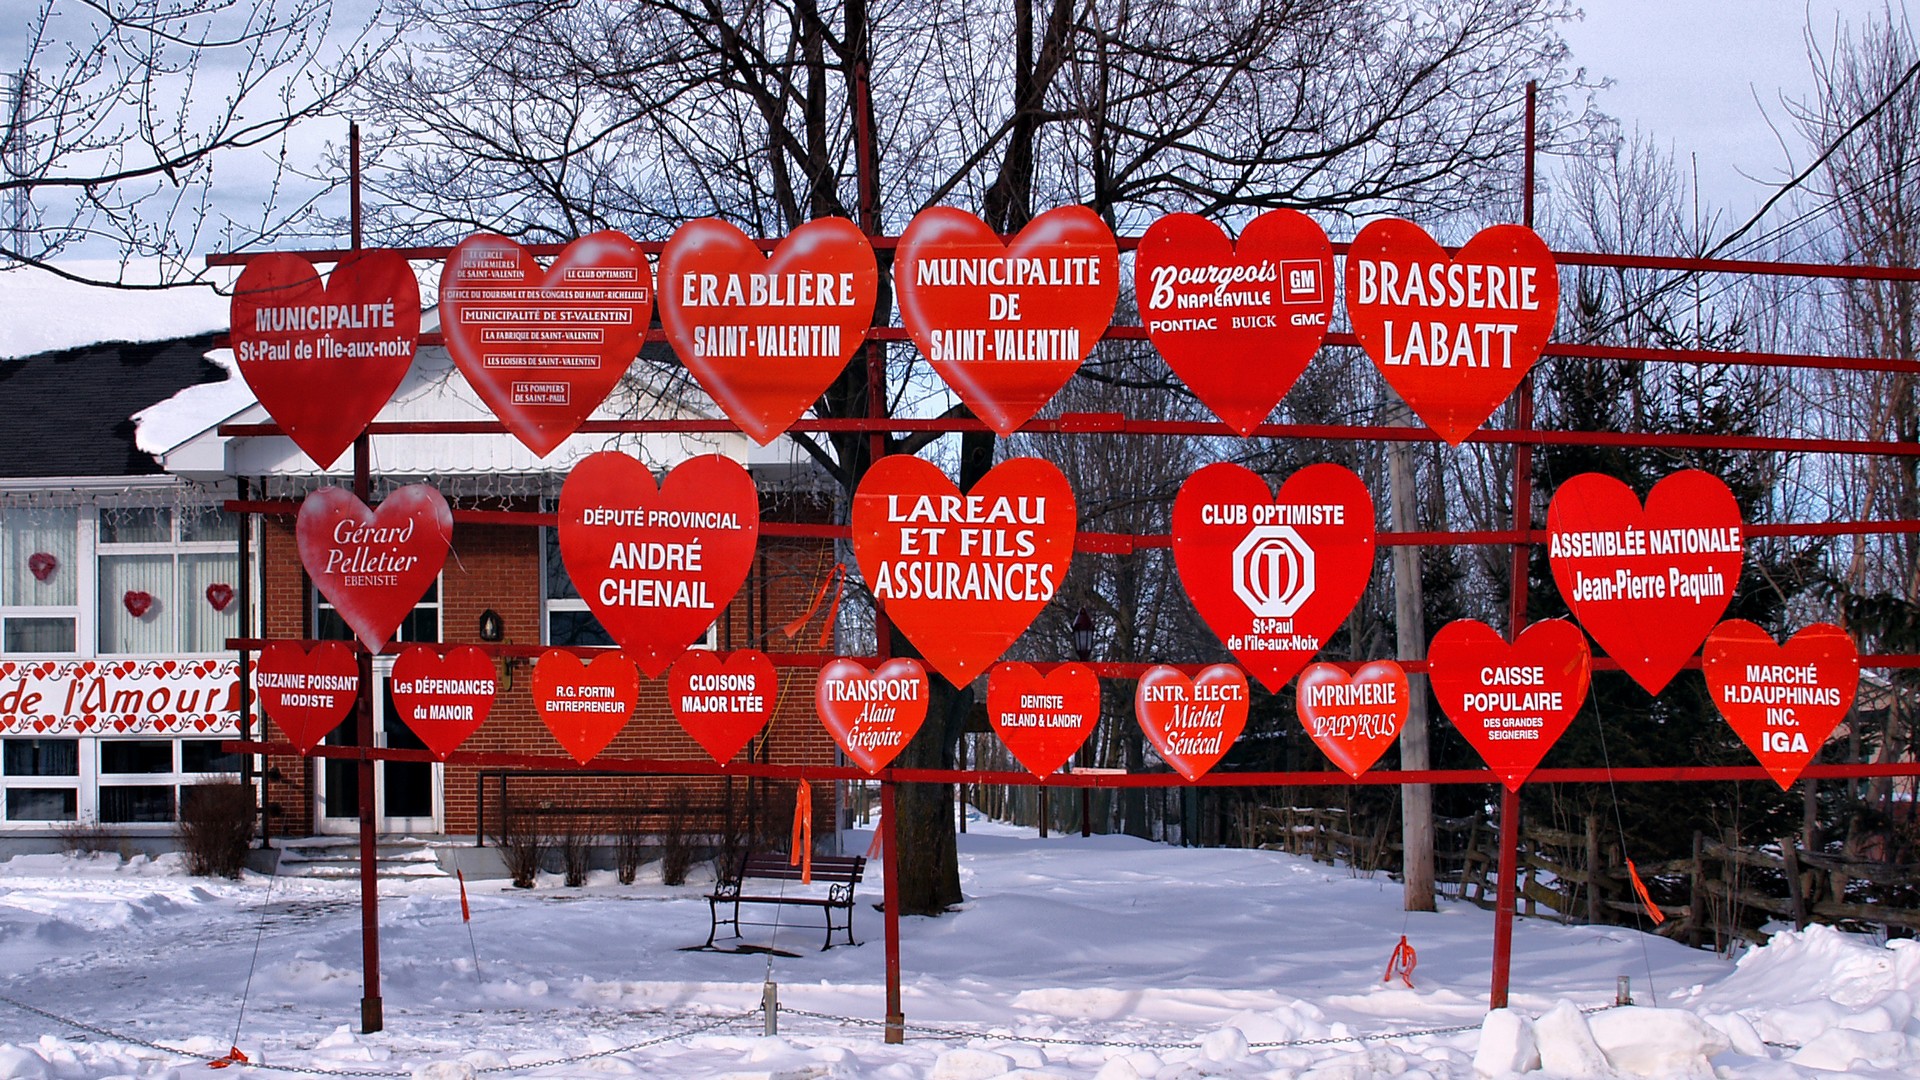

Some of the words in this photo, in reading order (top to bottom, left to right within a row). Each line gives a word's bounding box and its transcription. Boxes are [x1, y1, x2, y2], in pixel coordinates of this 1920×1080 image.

[464, 261, 476, 269] DES
[470, 251, 478, 259] LE
[479, 251, 503, 259] CERCLE
[458, 270, 466, 278] DE
[467, 270, 524, 278] SAINT-VALENTIN
[917, 255, 1100, 286] MUNICIPALITÉ
[1290, 270, 1315, 288] GM
[575, 291, 585, 299] DU
[586, 291, 643, 299] HAUT-RICHELIEU
[682, 270, 856, 306] ÉRABLIÈRE
[1149, 260, 1277, 309] Bourgeois
[1359, 260, 1539, 310] BRASSERIE
[256, 298, 394, 332] MUNICIPALITÉ
[466, 310, 540, 320] MUNICIPALITÉ
[544, 312, 557, 320] DE
[560, 312, 627, 321] ST-VALENTIN
[989, 294, 1021, 321] DE
[1151, 318, 1217, 335] PONTIAC
[1232, 316, 1277, 329] BUICK
[1291, 313, 1325, 326] GMC
[486, 332, 495, 340] LA
[497, 332, 529, 341] FABRIQUE
[531, 332, 540, 340] DE
[541, 332, 599, 340] SAINT-VALENTIN
[694, 326, 840, 357] SAINT-VALENTIN
[931, 329, 1079, 361] SAINT-VALENTIN
[1384, 321, 1518, 369] LABATT
[239, 340, 290, 361] St-Paul
[295, 340, 312, 359] de
[317, 334, 411, 358] l'Île-aux-noix
[538, 358, 596, 366] SAINT-VALENTIN
[584, 506, 644, 526] DÉPUTÉ
[649, 511, 741, 530] PROVINCIAL
[888, 495, 1046, 525] LAREAU
[1202, 504, 1247, 525] CLUB
[1252, 505, 1344, 525] OPTIMISTE
[334, 518, 414, 544] Gérard
[1551, 525, 1646, 558] ASSEMBLÉE
[1650, 527, 1740, 555] NATIONALE
[900, 528, 946, 555] ET
[960, 529, 1035, 557] FILS
[324, 546, 418, 573] Pelletier
[610, 537, 702, 571] ANDRÉ
[345, 575, 398, 587] EBENISTE
[874, 561, 1054, 601] ASSURANCES
[1573, 569, 1665, 601] Jean-Pierre
[1669, 566, 1724, 604] Paquin
[599, 579, 715, 609] CHENAIL
[1253, 618, 1293, 634] St-Paul
[1228, 634, 1242, 650] de
[258, 673, 305, 689] SUZANNE
[308, 675, 358, 691] POISSANT
[690, 675, 755, 691] CLOISONS
[1481, 667, 1544, 686] CAISSE
[1746, 663, 1818, 684] MARCHÉ
[394, 679, 412, 694] Les
[416, 676, 494, 695] DÉPENDANCES
[556, 686, 576, 697] R.G.
[579, 687, 615, 698] FORTIN
[826, 679, 920, 701] TRANSPORT
[1144, 686, 1189, 702] ENTR.
[1194, 682, 1243, 701] ÉLECT.
[1307, 683, 1396, 707] IMPRIMERIE
[1724, 685, 1840, 706] H.DAUPHINAIS
[0, 678, 42, 715] de
[63, 677, 221, 716] l'Amour
[281, 694, 334, 708] MODISTE
[546, 701, 625, 713] ENTREPRENEUR
[682, 696, 728, 712] MAJOR
[731, 693, 763, 712] LTÉE
[1021, 695, 1063, 709] DENTISTE
[1463, 693, 1563, 712] POPULAIRE
[414, 705, 427, 719] du
[430, 705, 473, 720] MANOIR
[855, 702, 896, 724] Alain
[1001, 713, 1037, 727] DELAND
[1038, 714, 1045, 727] &
[1047, 714, 1082, 728] LANDRY
[1164, 704, 1225, 732] Michel
[1484, 718, 1500, 728] DES
[1502, 718, 1543, 727] GRANDES
[1767, 708, 1800, 726] INC.
[1313, 714, 1396, 741] PAPYRUS
[1489, 730, 1539, 740] SEIGNERIES
[847, 726, 902, 752] Grégoire
[1164, 731, 1223, 755] Sénécal
[1762, 732, 1809, 753] IGA
